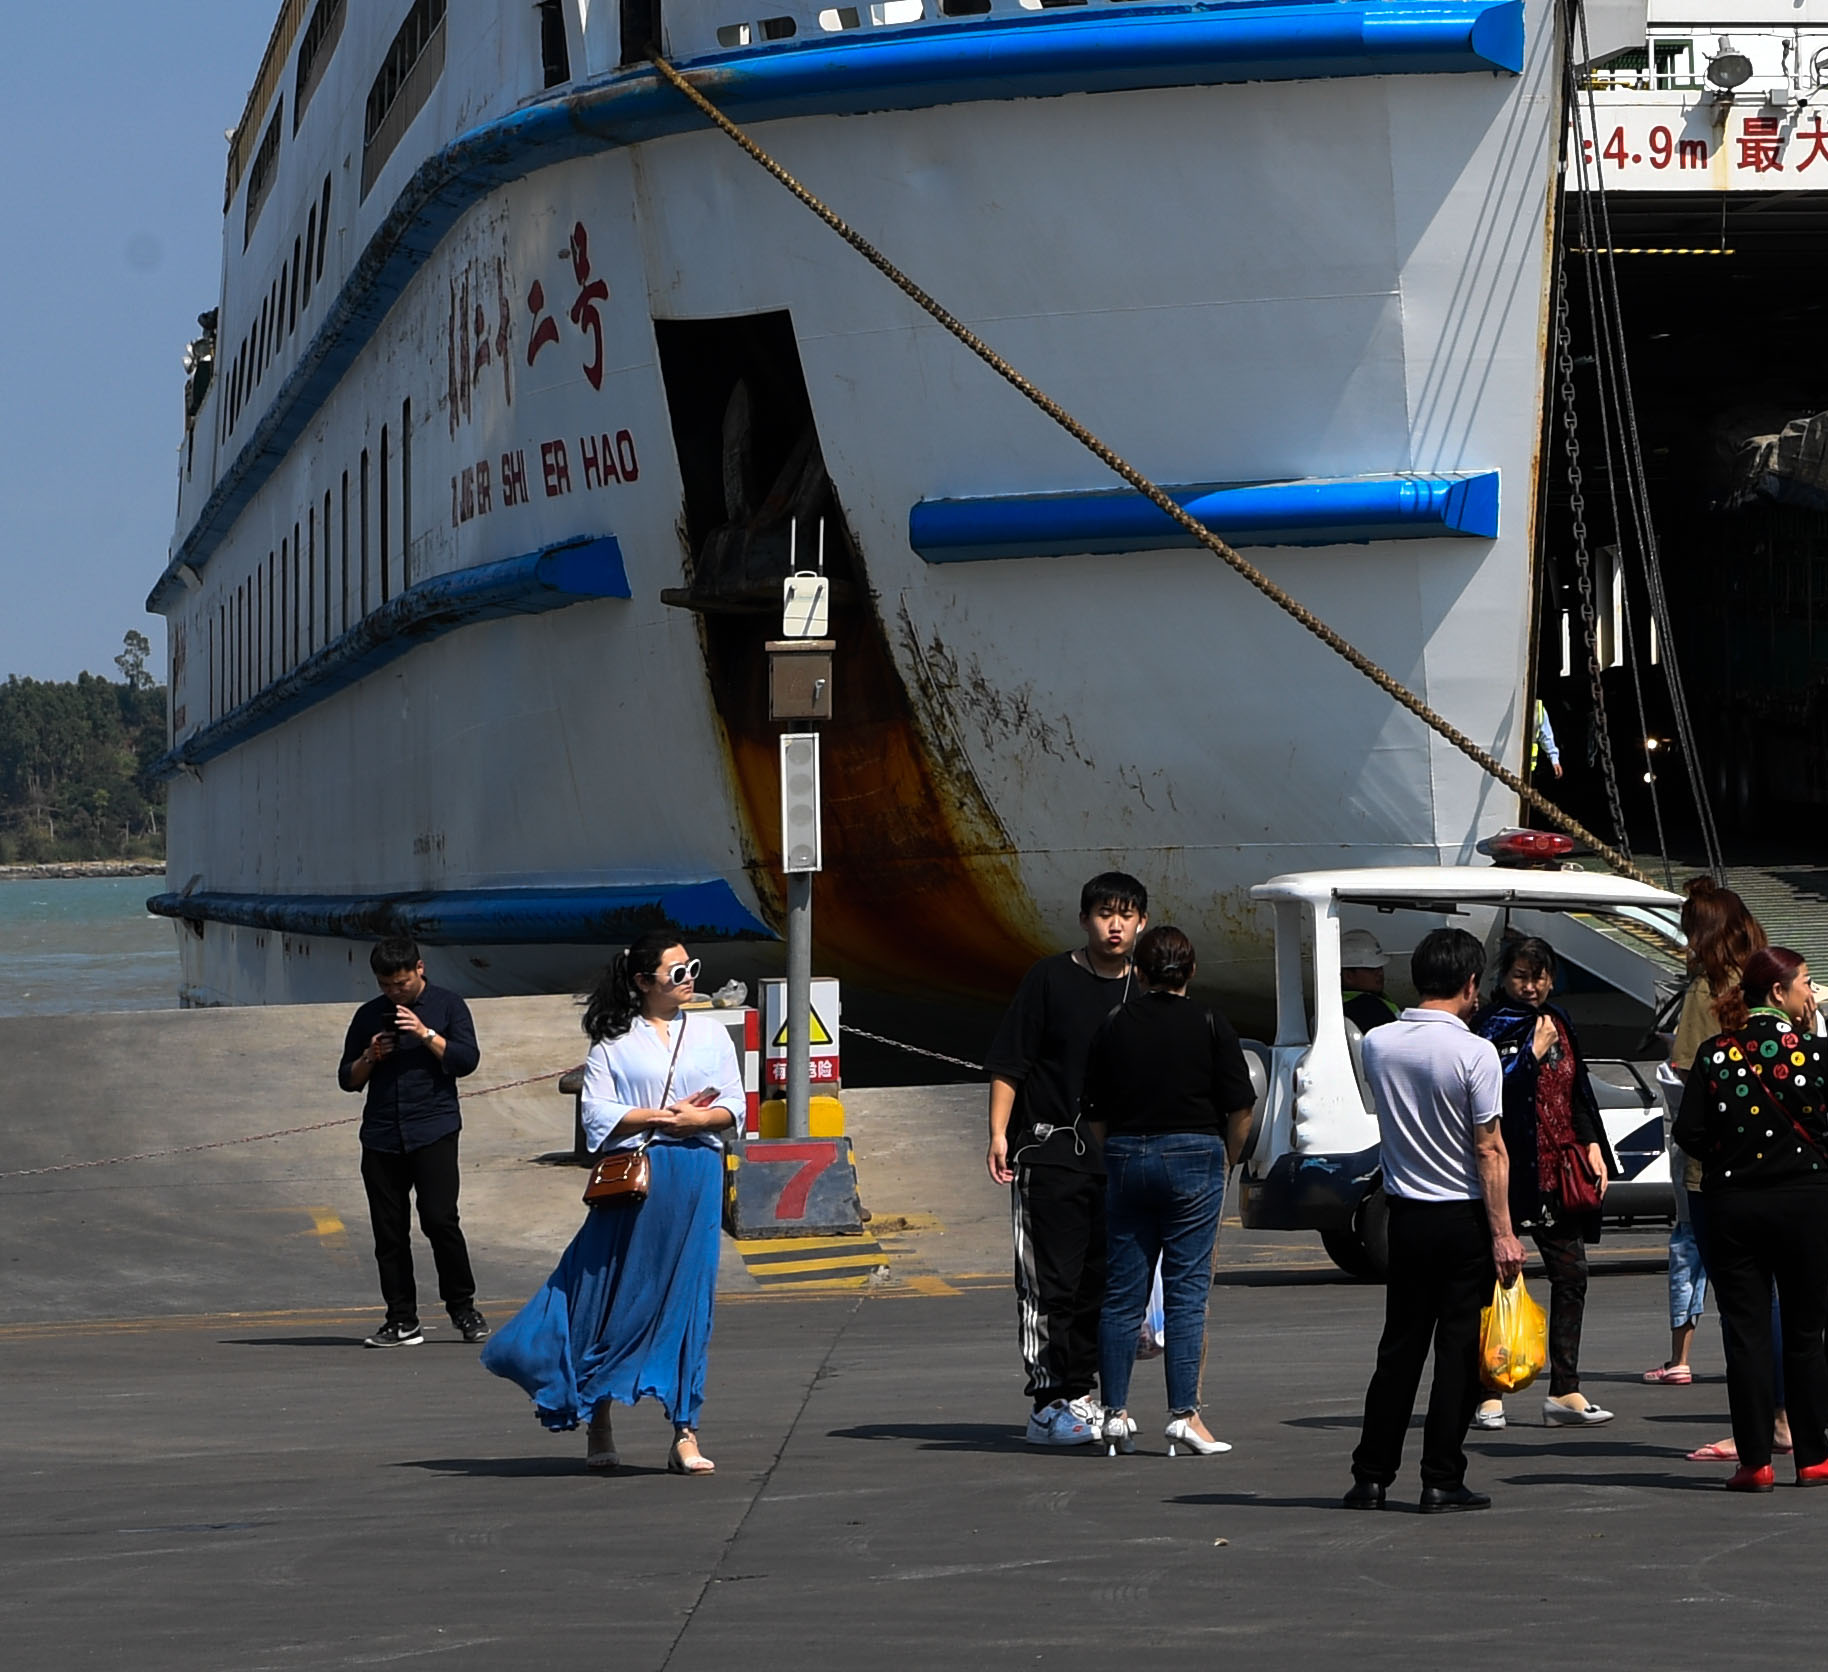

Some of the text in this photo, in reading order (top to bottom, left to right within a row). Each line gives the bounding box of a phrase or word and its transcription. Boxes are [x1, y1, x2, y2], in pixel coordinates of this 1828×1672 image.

[502, 448, 529, 507] SHI
[540, 438, 572, 498] ER
[580, 428, 639, 491] HAO
[745, 1141, 838, 1221] 7
